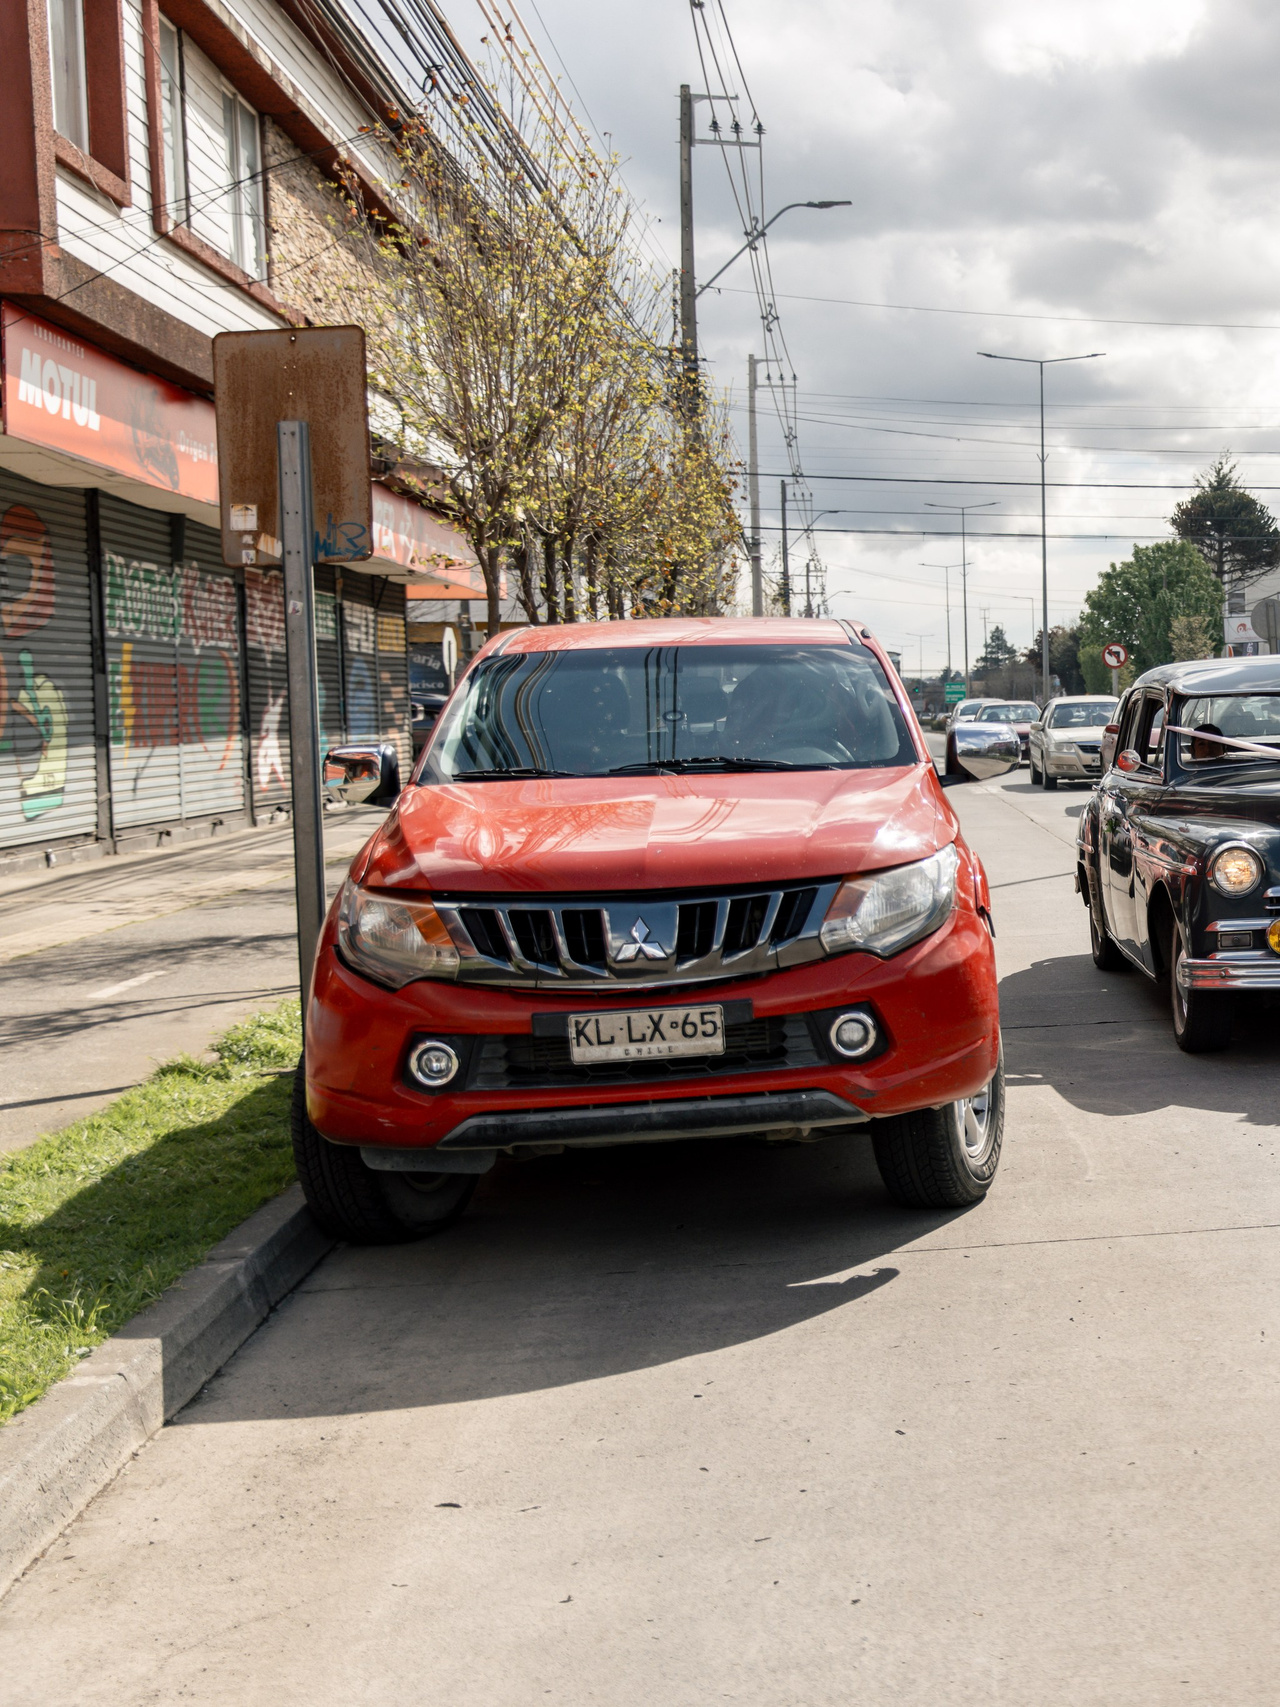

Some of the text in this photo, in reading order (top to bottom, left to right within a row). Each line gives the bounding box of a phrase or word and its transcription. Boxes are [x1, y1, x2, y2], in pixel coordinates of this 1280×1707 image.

[18, 347, 100, 431] MOTUL
[412, 653, 442, 671] aria
[624, 1045, 674, 1057] CHILE
